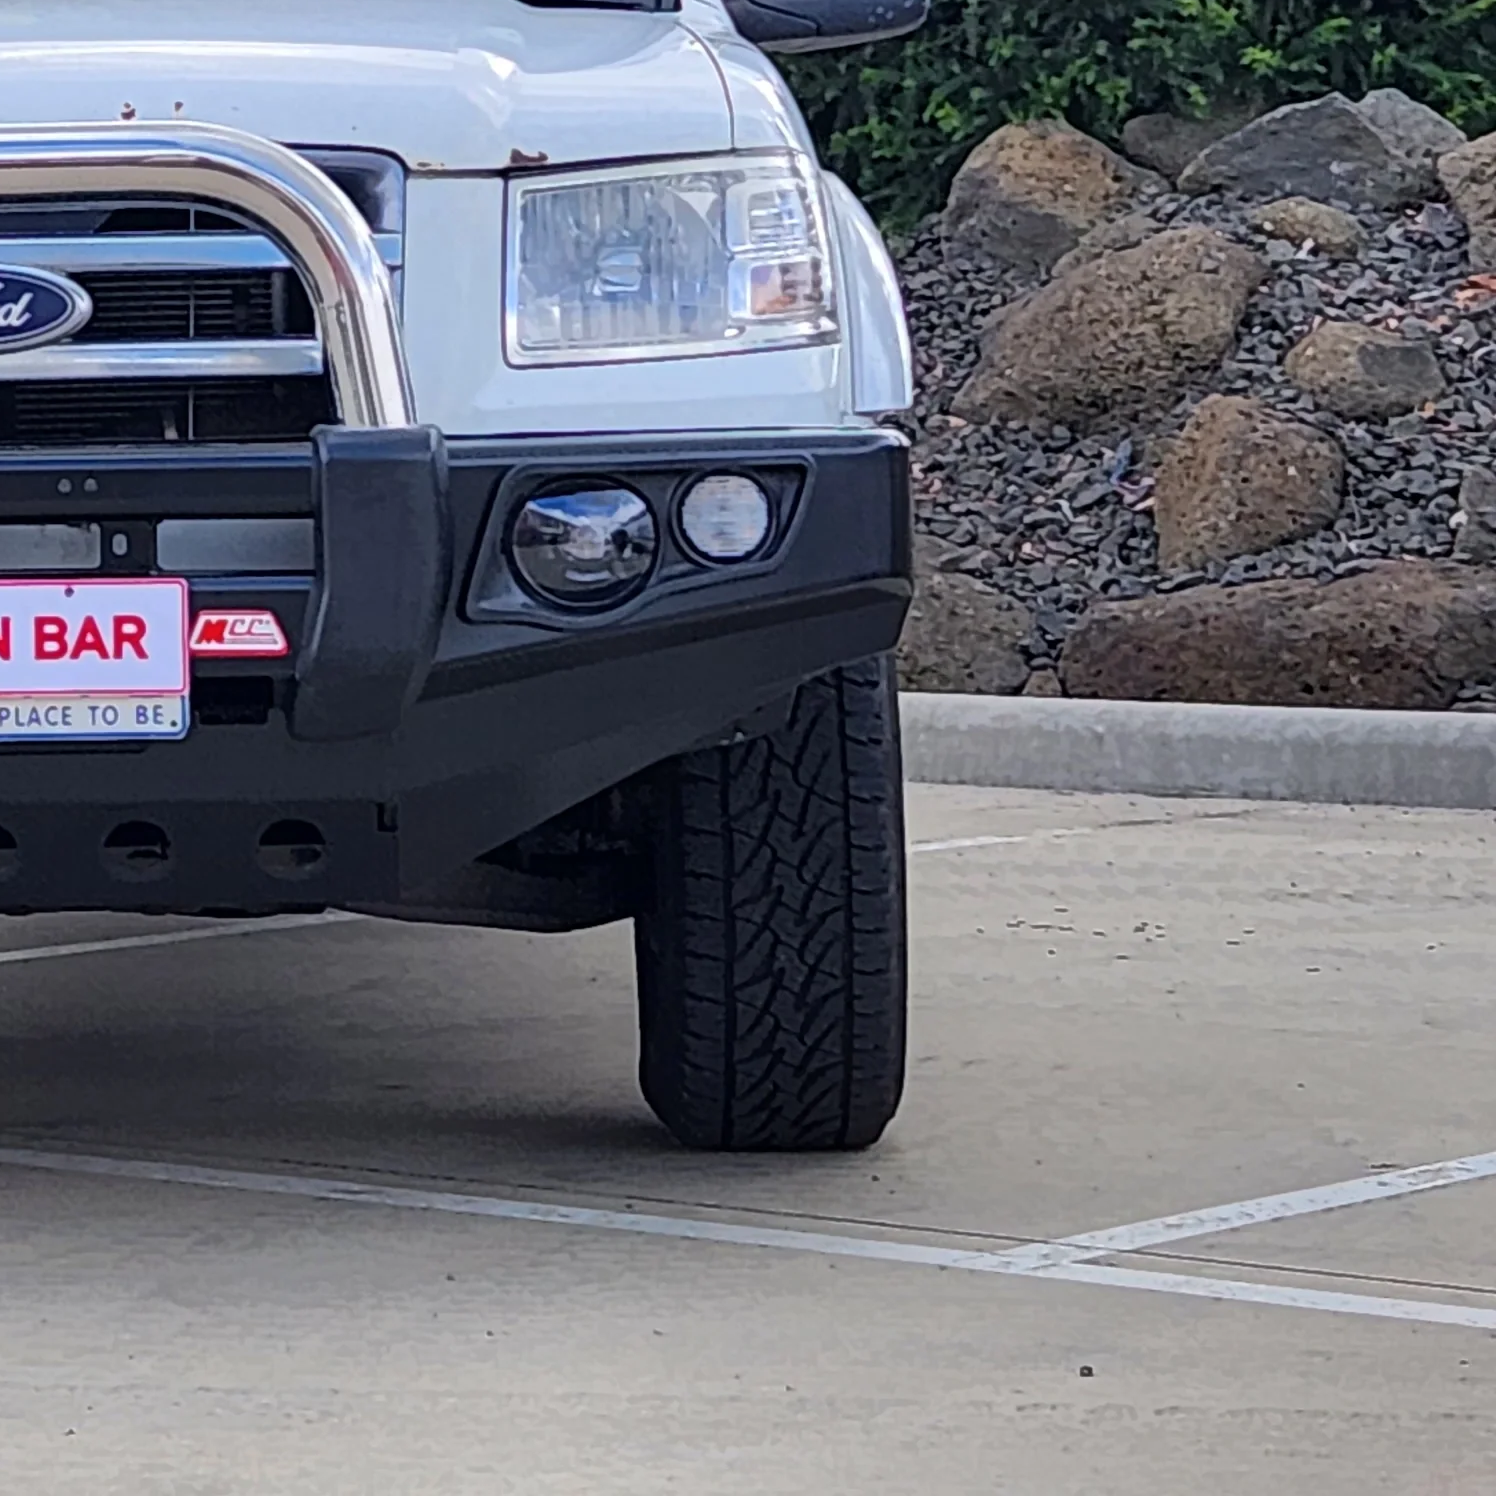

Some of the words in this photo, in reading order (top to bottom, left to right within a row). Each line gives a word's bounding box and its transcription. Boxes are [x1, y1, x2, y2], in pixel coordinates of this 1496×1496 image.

[34, 615, 149, 660] BAR
[88, 706, 119, 726] TO
[135, 704, 164, 725] BE
